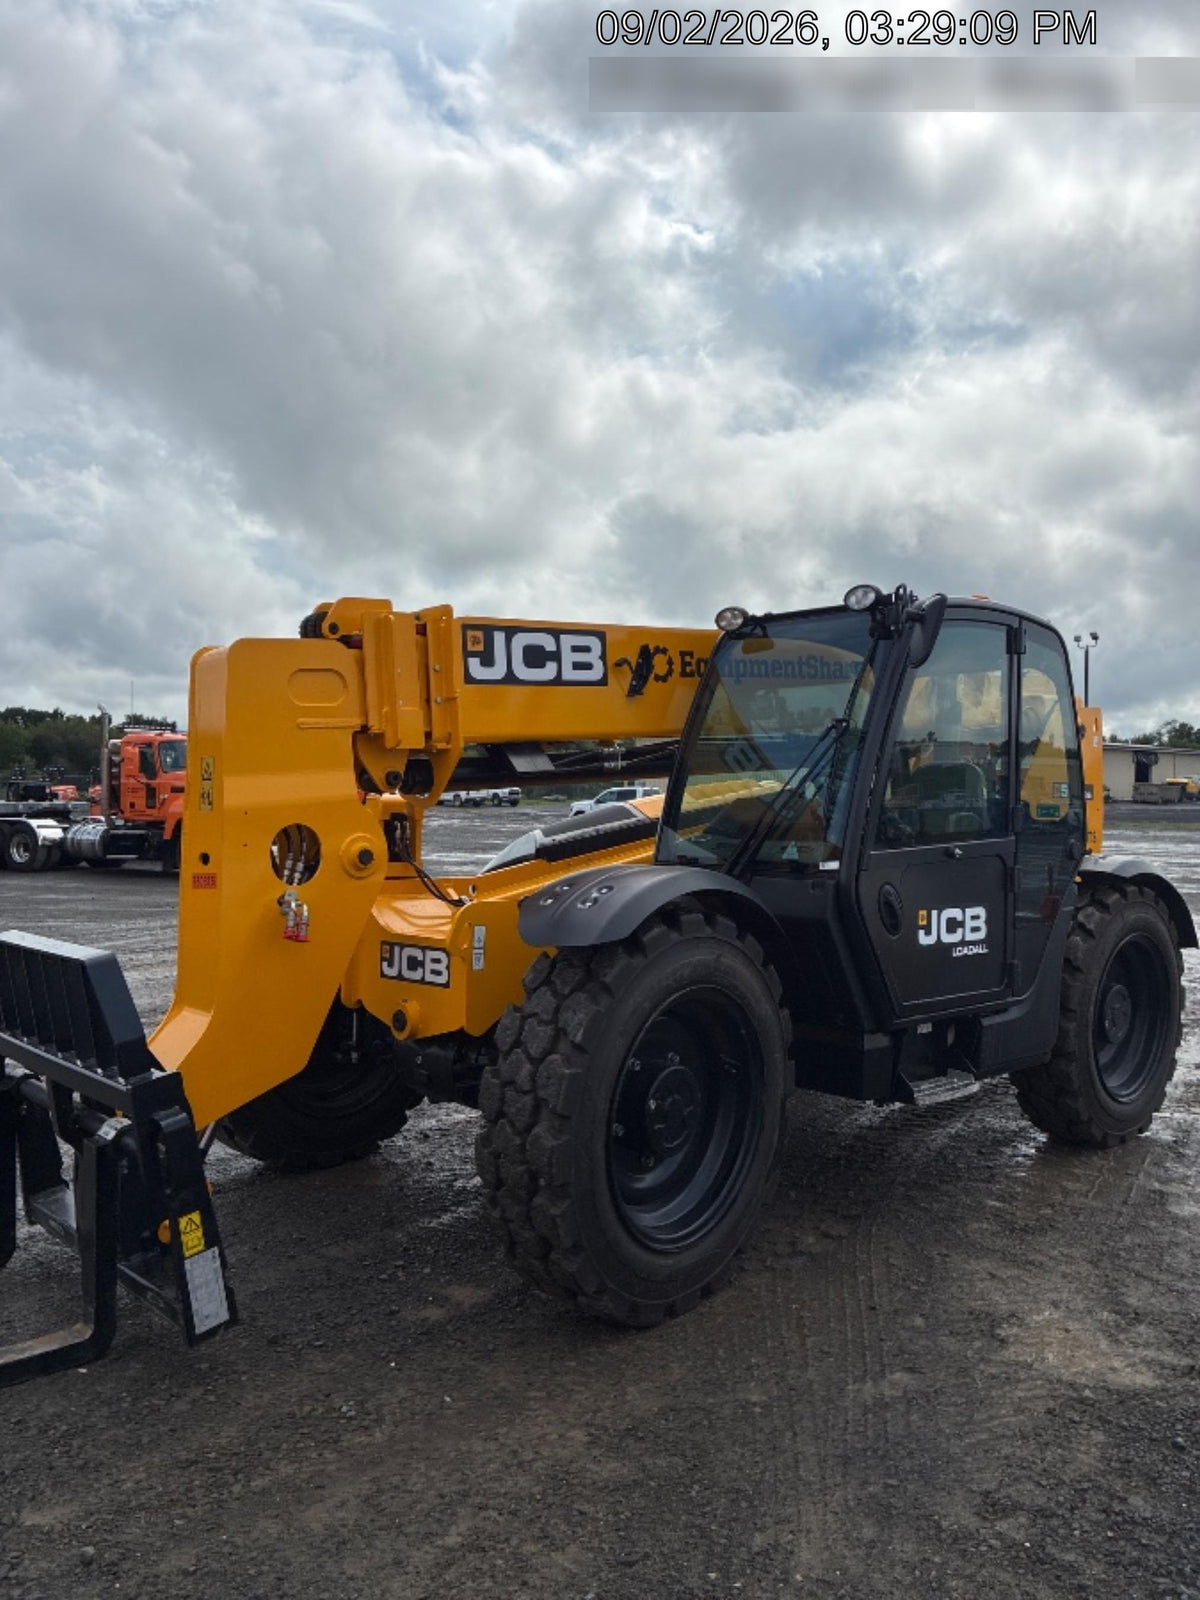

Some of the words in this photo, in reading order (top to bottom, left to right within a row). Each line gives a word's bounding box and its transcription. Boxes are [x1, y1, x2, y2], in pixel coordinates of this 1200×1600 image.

[467, 630, 605, 682] JCB
[679, 651, 863, 684] EqipmentShar
[918, 906, 987, 946] JCB
[382, 945, 449, 984] JCB
